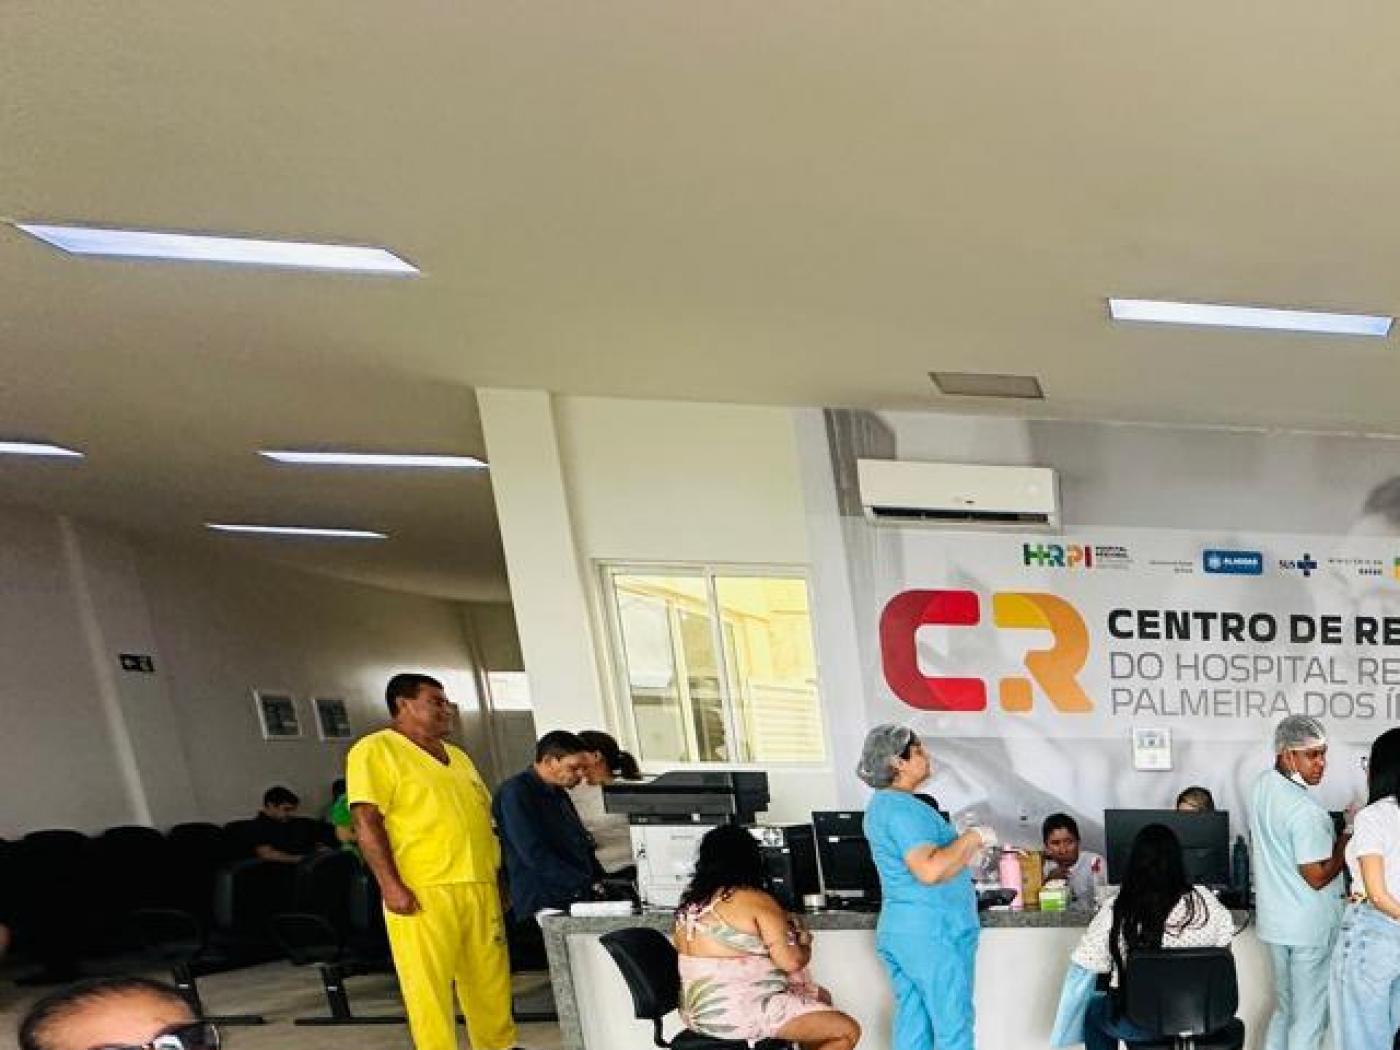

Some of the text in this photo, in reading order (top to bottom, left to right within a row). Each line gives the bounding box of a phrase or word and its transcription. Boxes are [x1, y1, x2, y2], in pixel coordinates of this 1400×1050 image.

[1108, 608, 1277, 643] CENTRO
[1290, 614, 1343, 645] DE
[879, 589, 1094, 713] CR
[1110, 651, 1164, 681] DO
[1176, 653, 1348, 685] HOSPITAL
[1111, 688, 1292, 719] PALMEIRA
[1304, 692, 1376, 719] DOS
